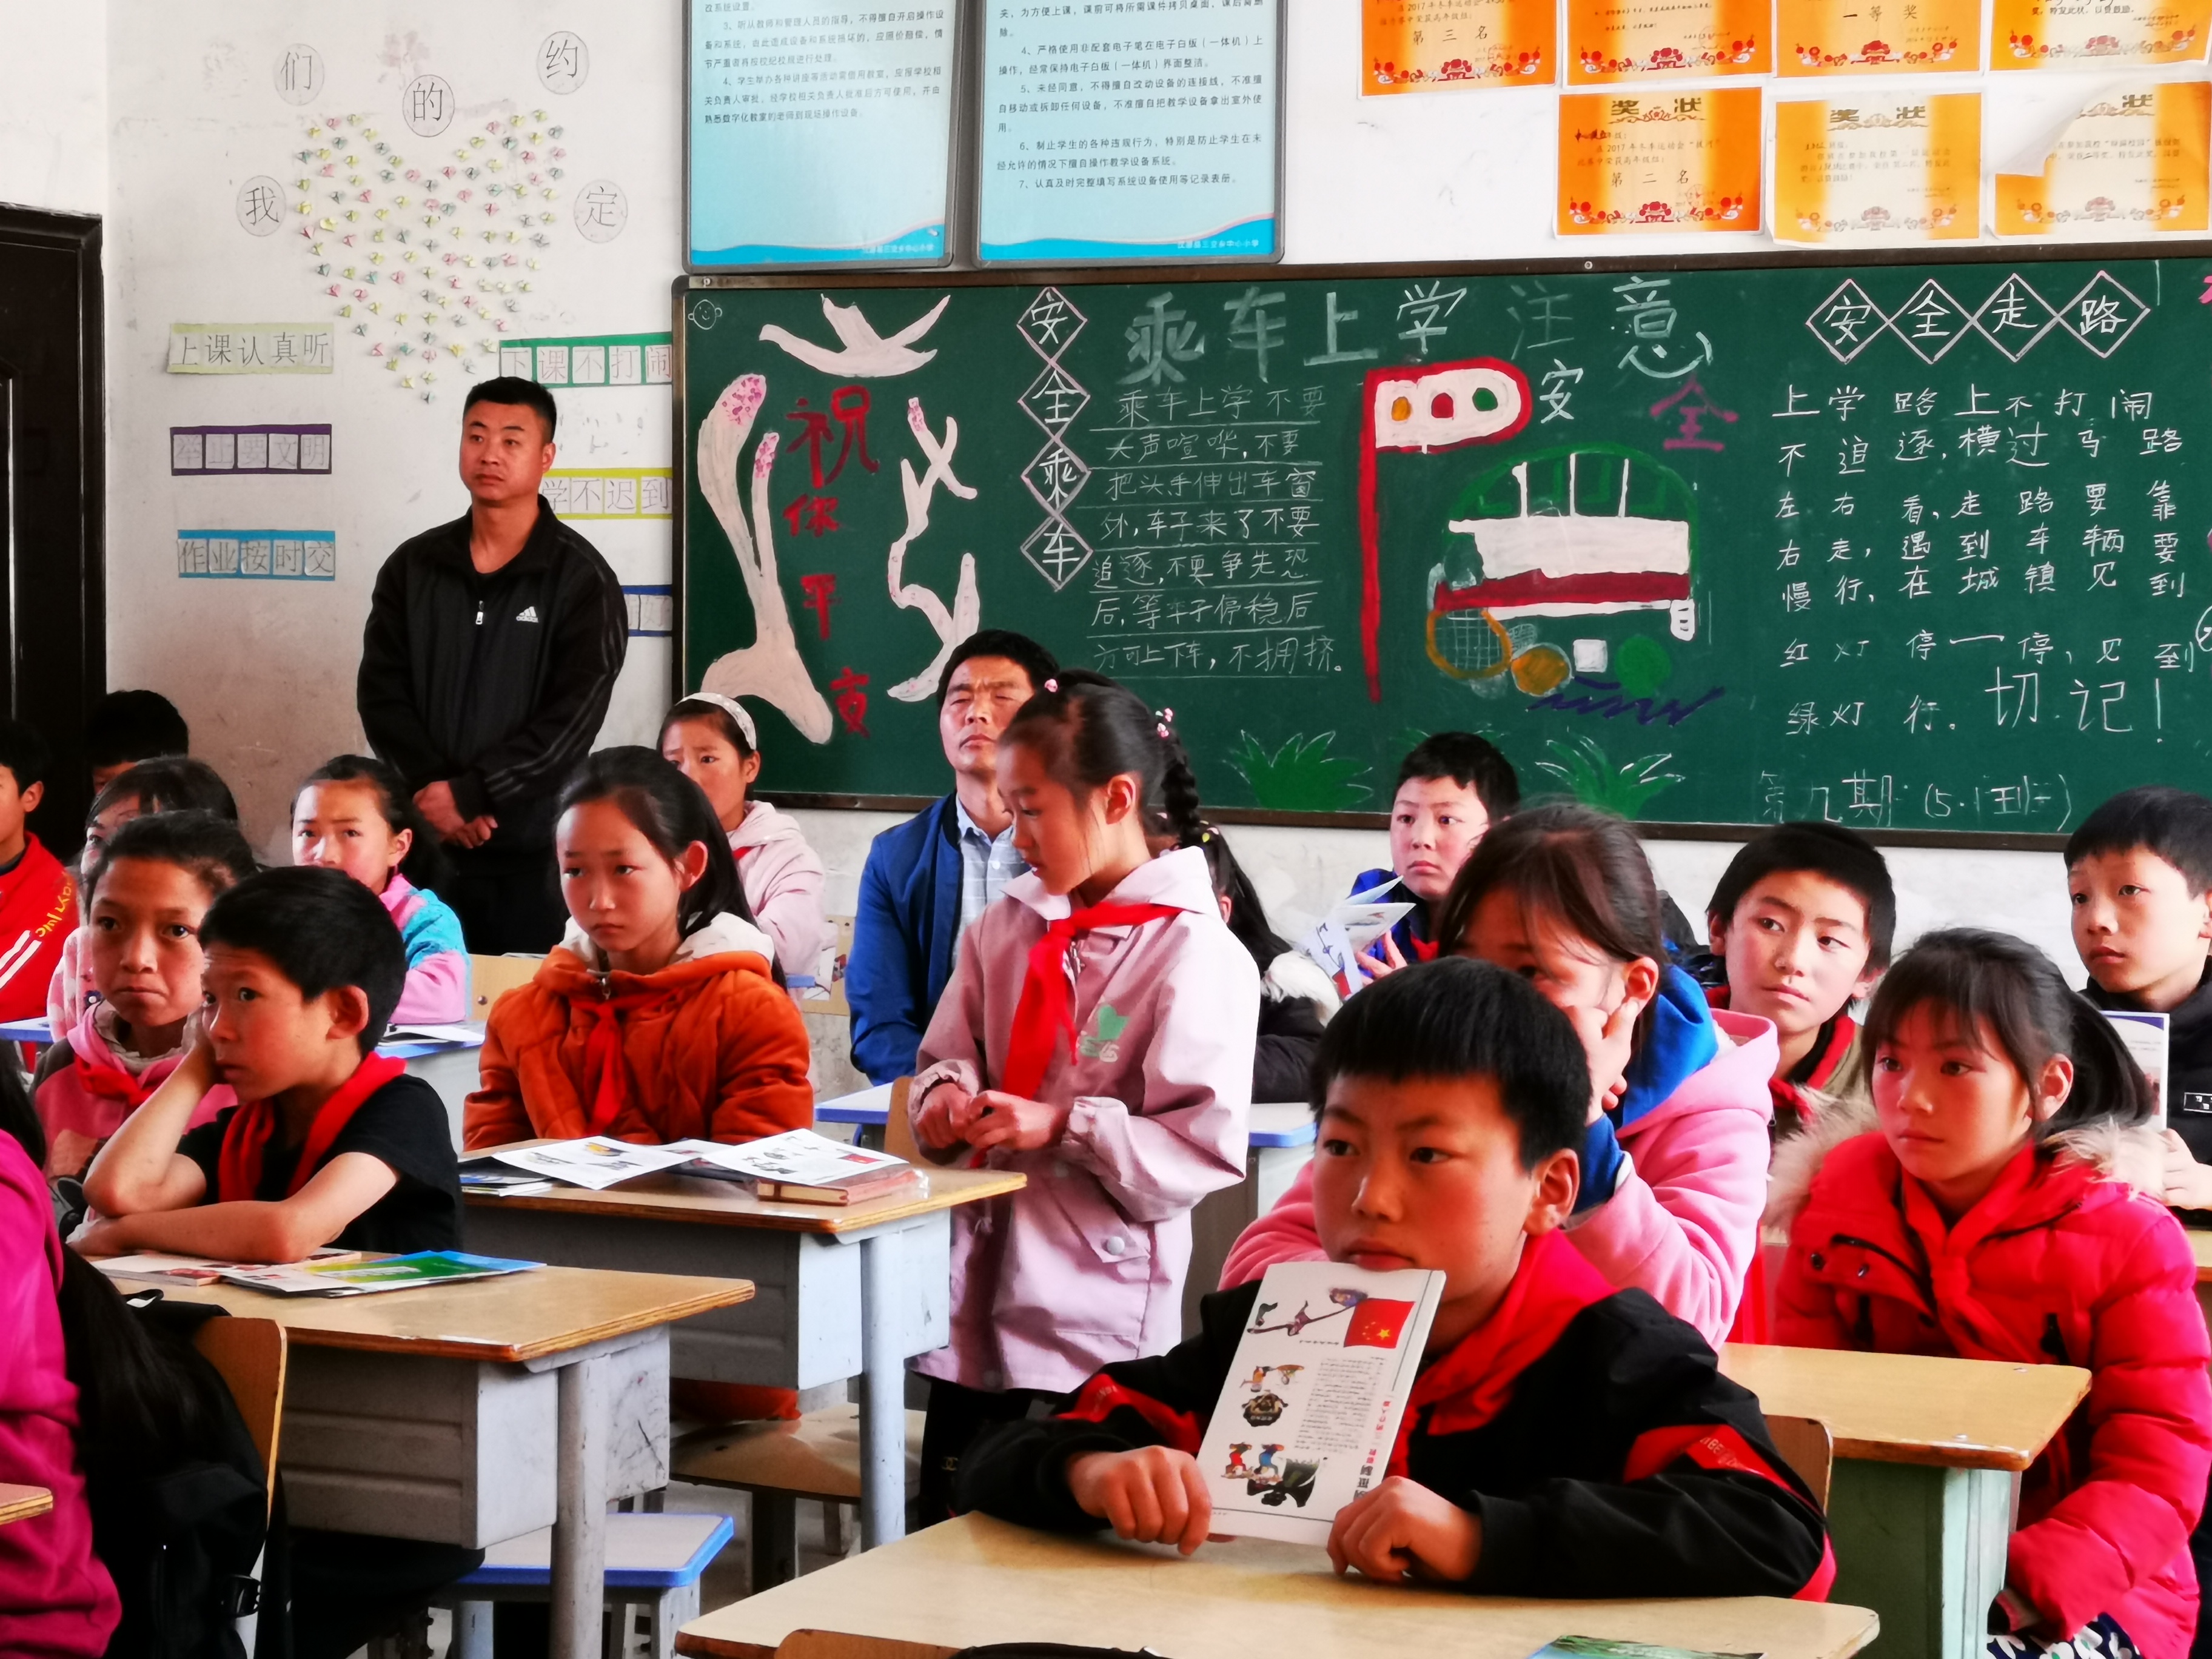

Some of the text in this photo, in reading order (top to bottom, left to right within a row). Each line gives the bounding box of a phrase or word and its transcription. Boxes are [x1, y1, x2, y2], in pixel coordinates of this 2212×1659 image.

[1115, 276, 1713, 387] 乘车上学注意
[1822, 282, 2128, 346] 安全走路
[172, 332, 329, 366] 上课认真听
[502, 346, 671, 381] 下课不打闹
[1116, 385, 1327, 427] 乘车上学不要
[1772, 383, 2153, 421] 上学路上不打闹
[176, 435, 326, 467] 举止要文明
[1031, 292, 1081, 581] 安全乘车
[181, 540, 333, 574] 作业按时交
